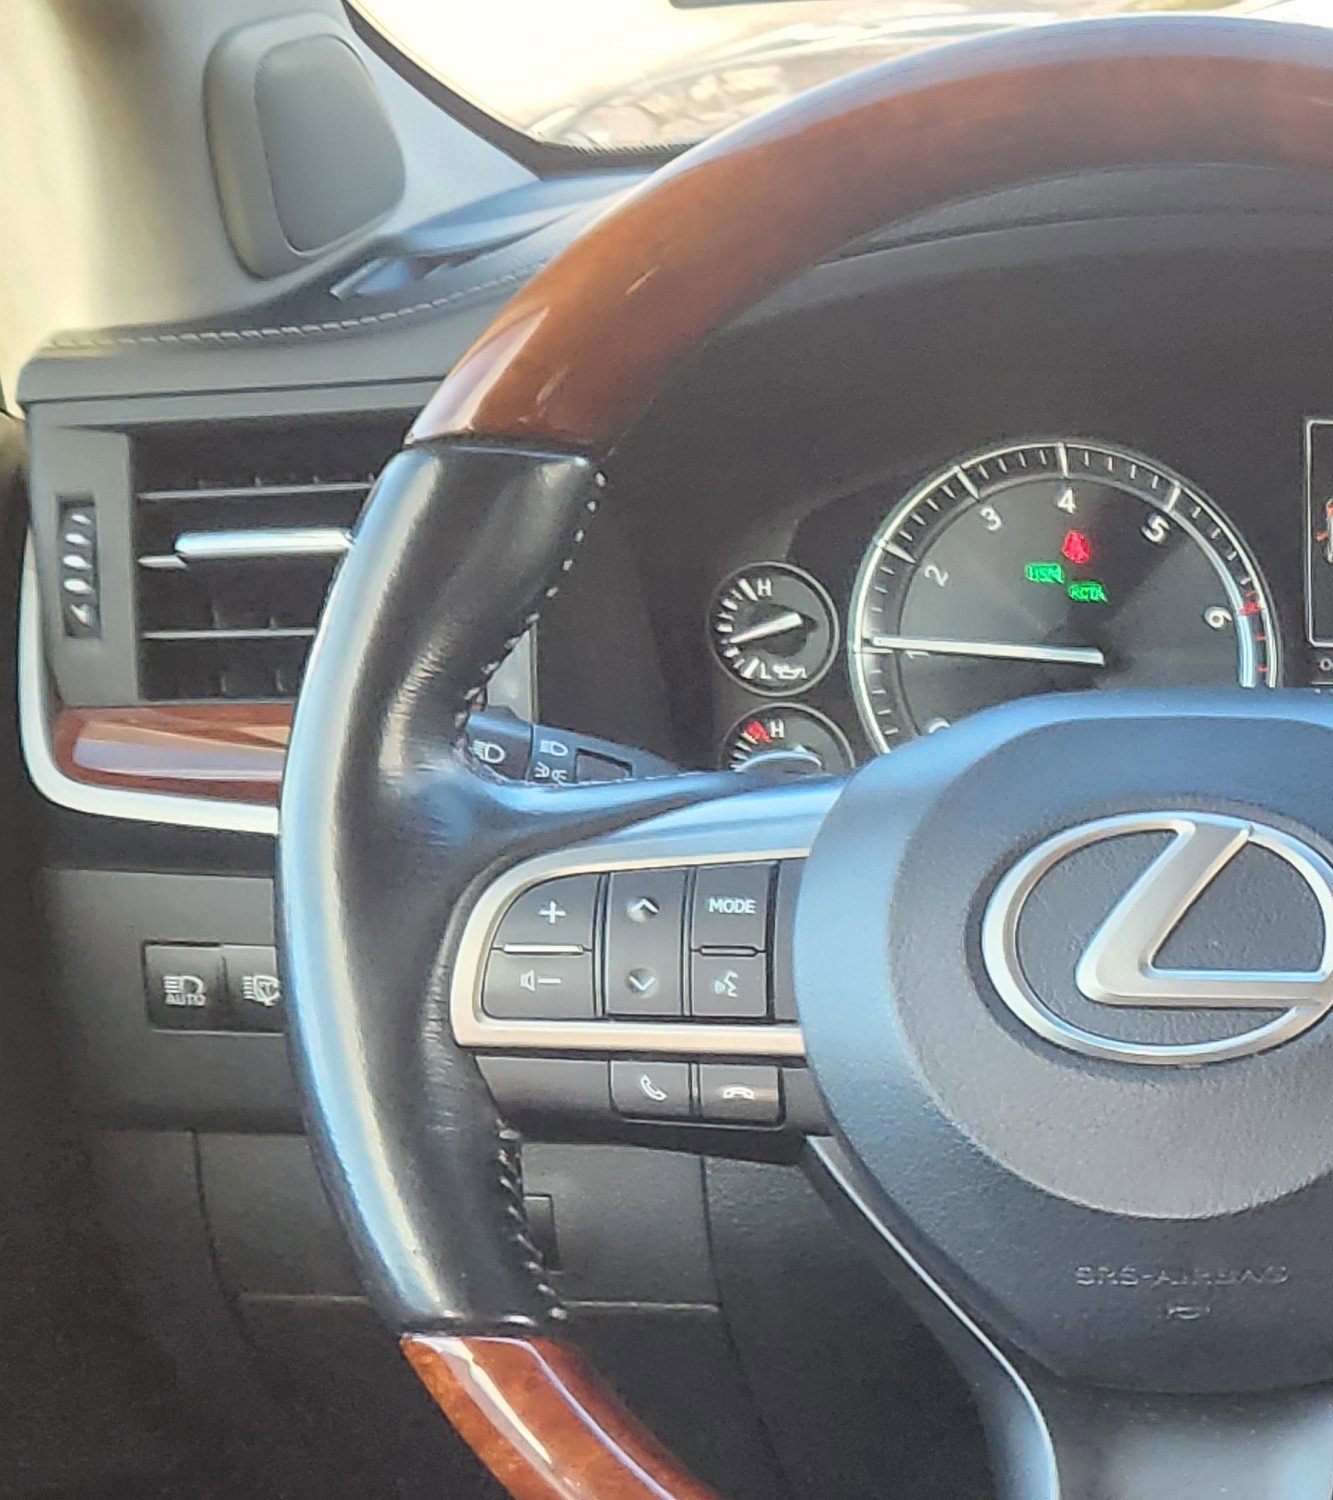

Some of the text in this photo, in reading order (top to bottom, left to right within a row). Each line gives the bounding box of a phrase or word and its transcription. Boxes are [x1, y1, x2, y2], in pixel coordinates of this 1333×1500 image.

[1057, 489, 1076, 514] 4
[980, 506, 1001, 532] 3
[1142, 515, 1169, 543] 5
[757, 578, 772, 596] H
[924, 565, 949, 587] 2
[1204, 606, 1233, 629] 6
[770, 719, 785, 738] H
[708, 898, 756, 914] MODE
[165, 993, 206, 1006] AUTO
